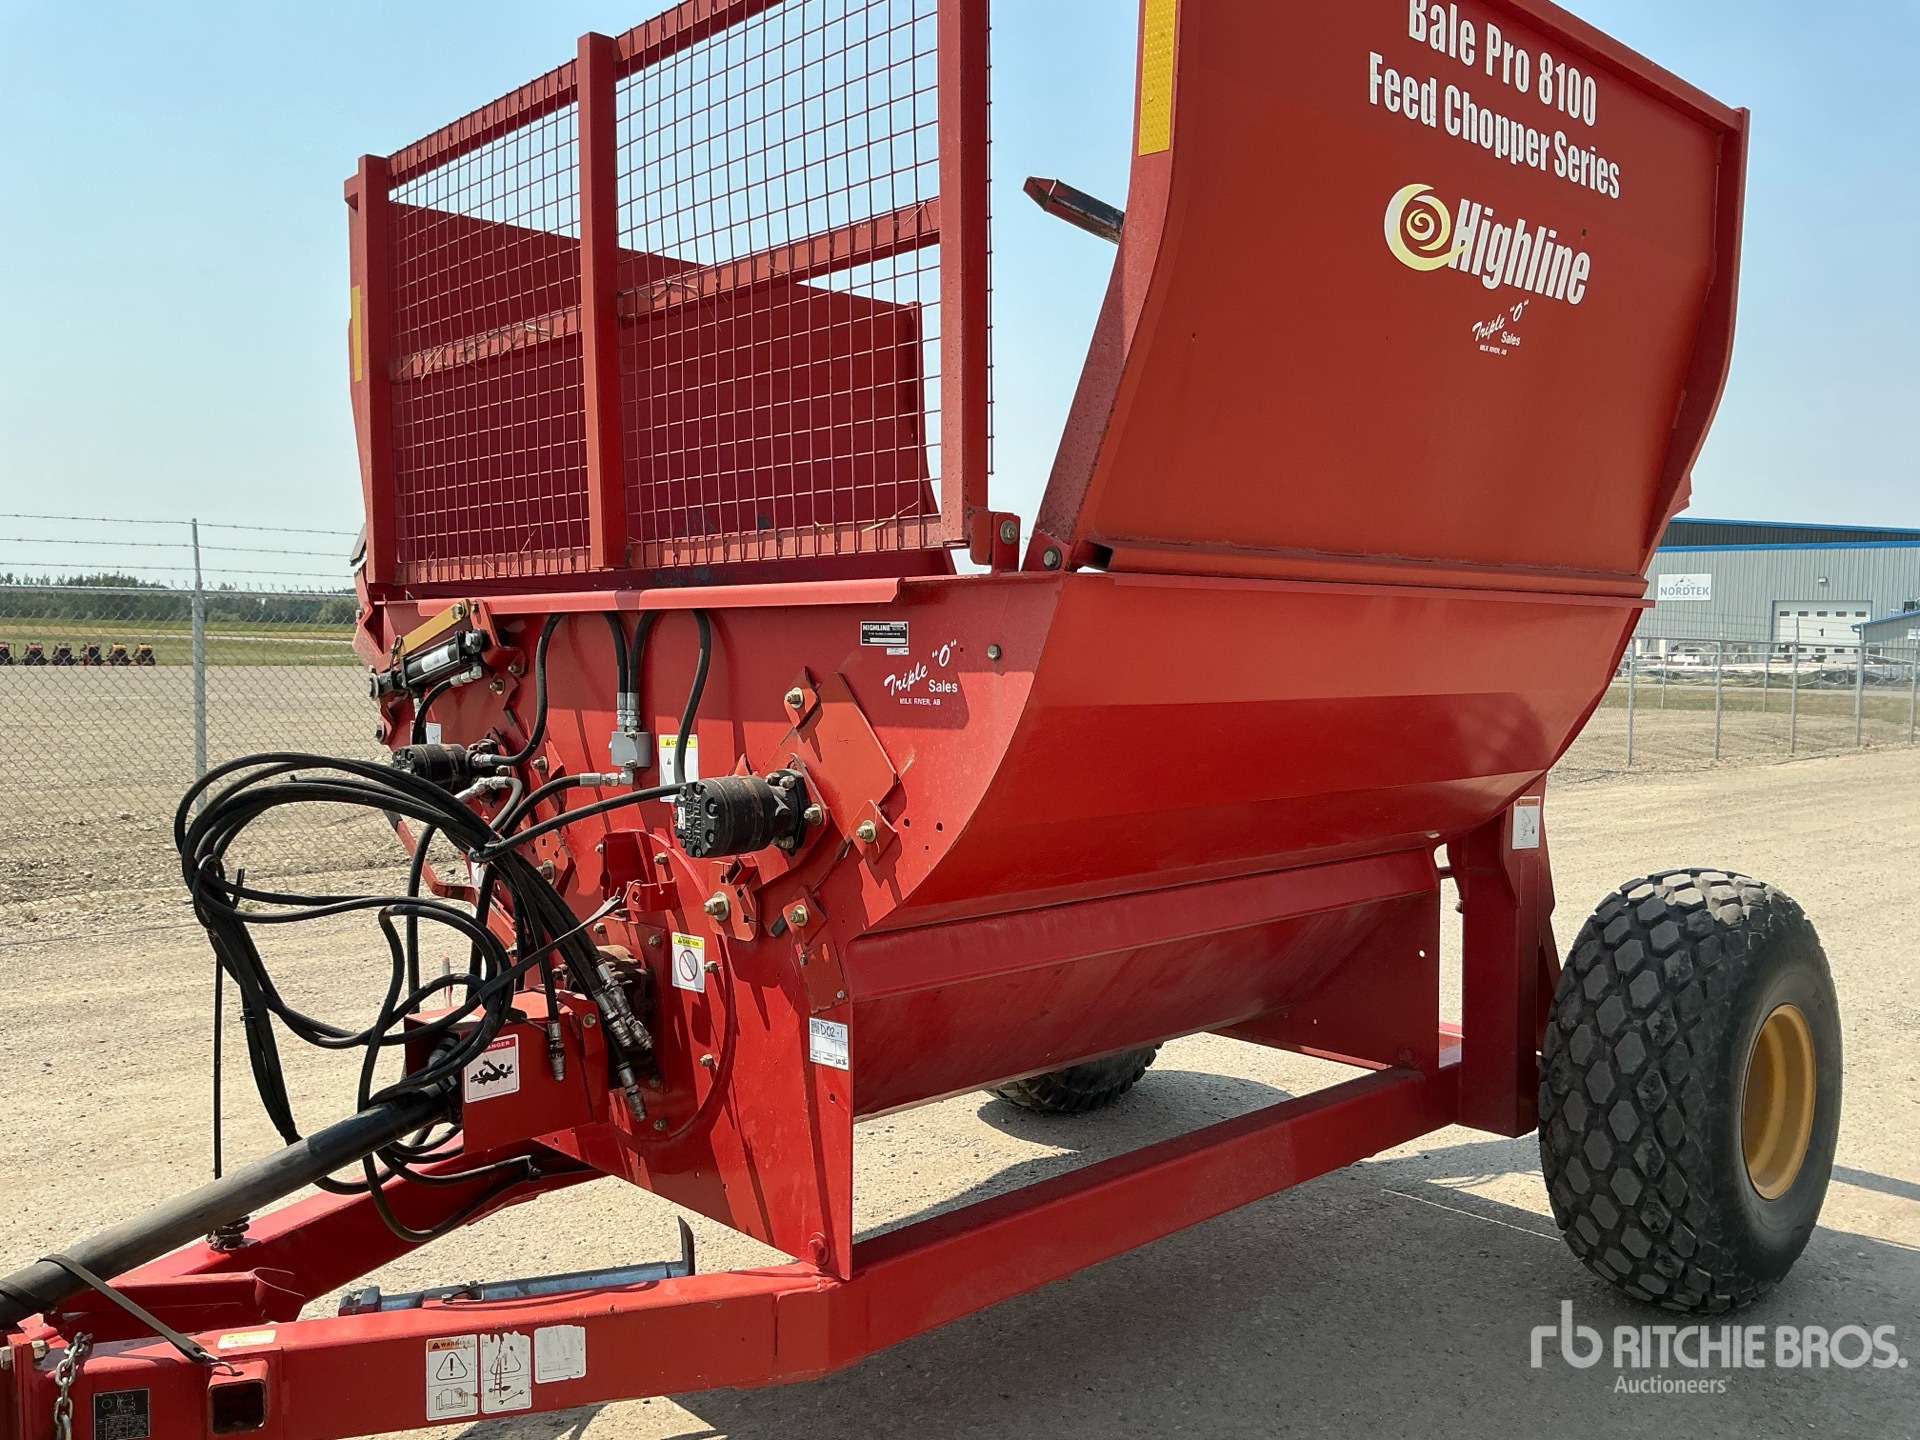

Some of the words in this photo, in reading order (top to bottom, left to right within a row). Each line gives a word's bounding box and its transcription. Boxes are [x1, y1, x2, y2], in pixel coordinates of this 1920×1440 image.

[1408, 0, 1477, 66] Bale
[1485, 22, 1530, 94] Pro
[1538, 52, 1597, 127] 8100
[1369, 51, 1438, 128] Feed
[1444, 83, 1551, 171] Chopper
[1554, 130, 1621, 199] Series
[1448, 198, 1591, 306] Highline
[1472, 313, 1505, 342] Triple
[1501, 331, 1521, 346] Sales
[1660, 586, 1710, 596] NORDTEK
[883, 661, 929, 696] Triple
[928, 679, 958, 693] Sales
[932, 698, 941, 706] AB
[487, 1040, 510, 1050] ANGER
